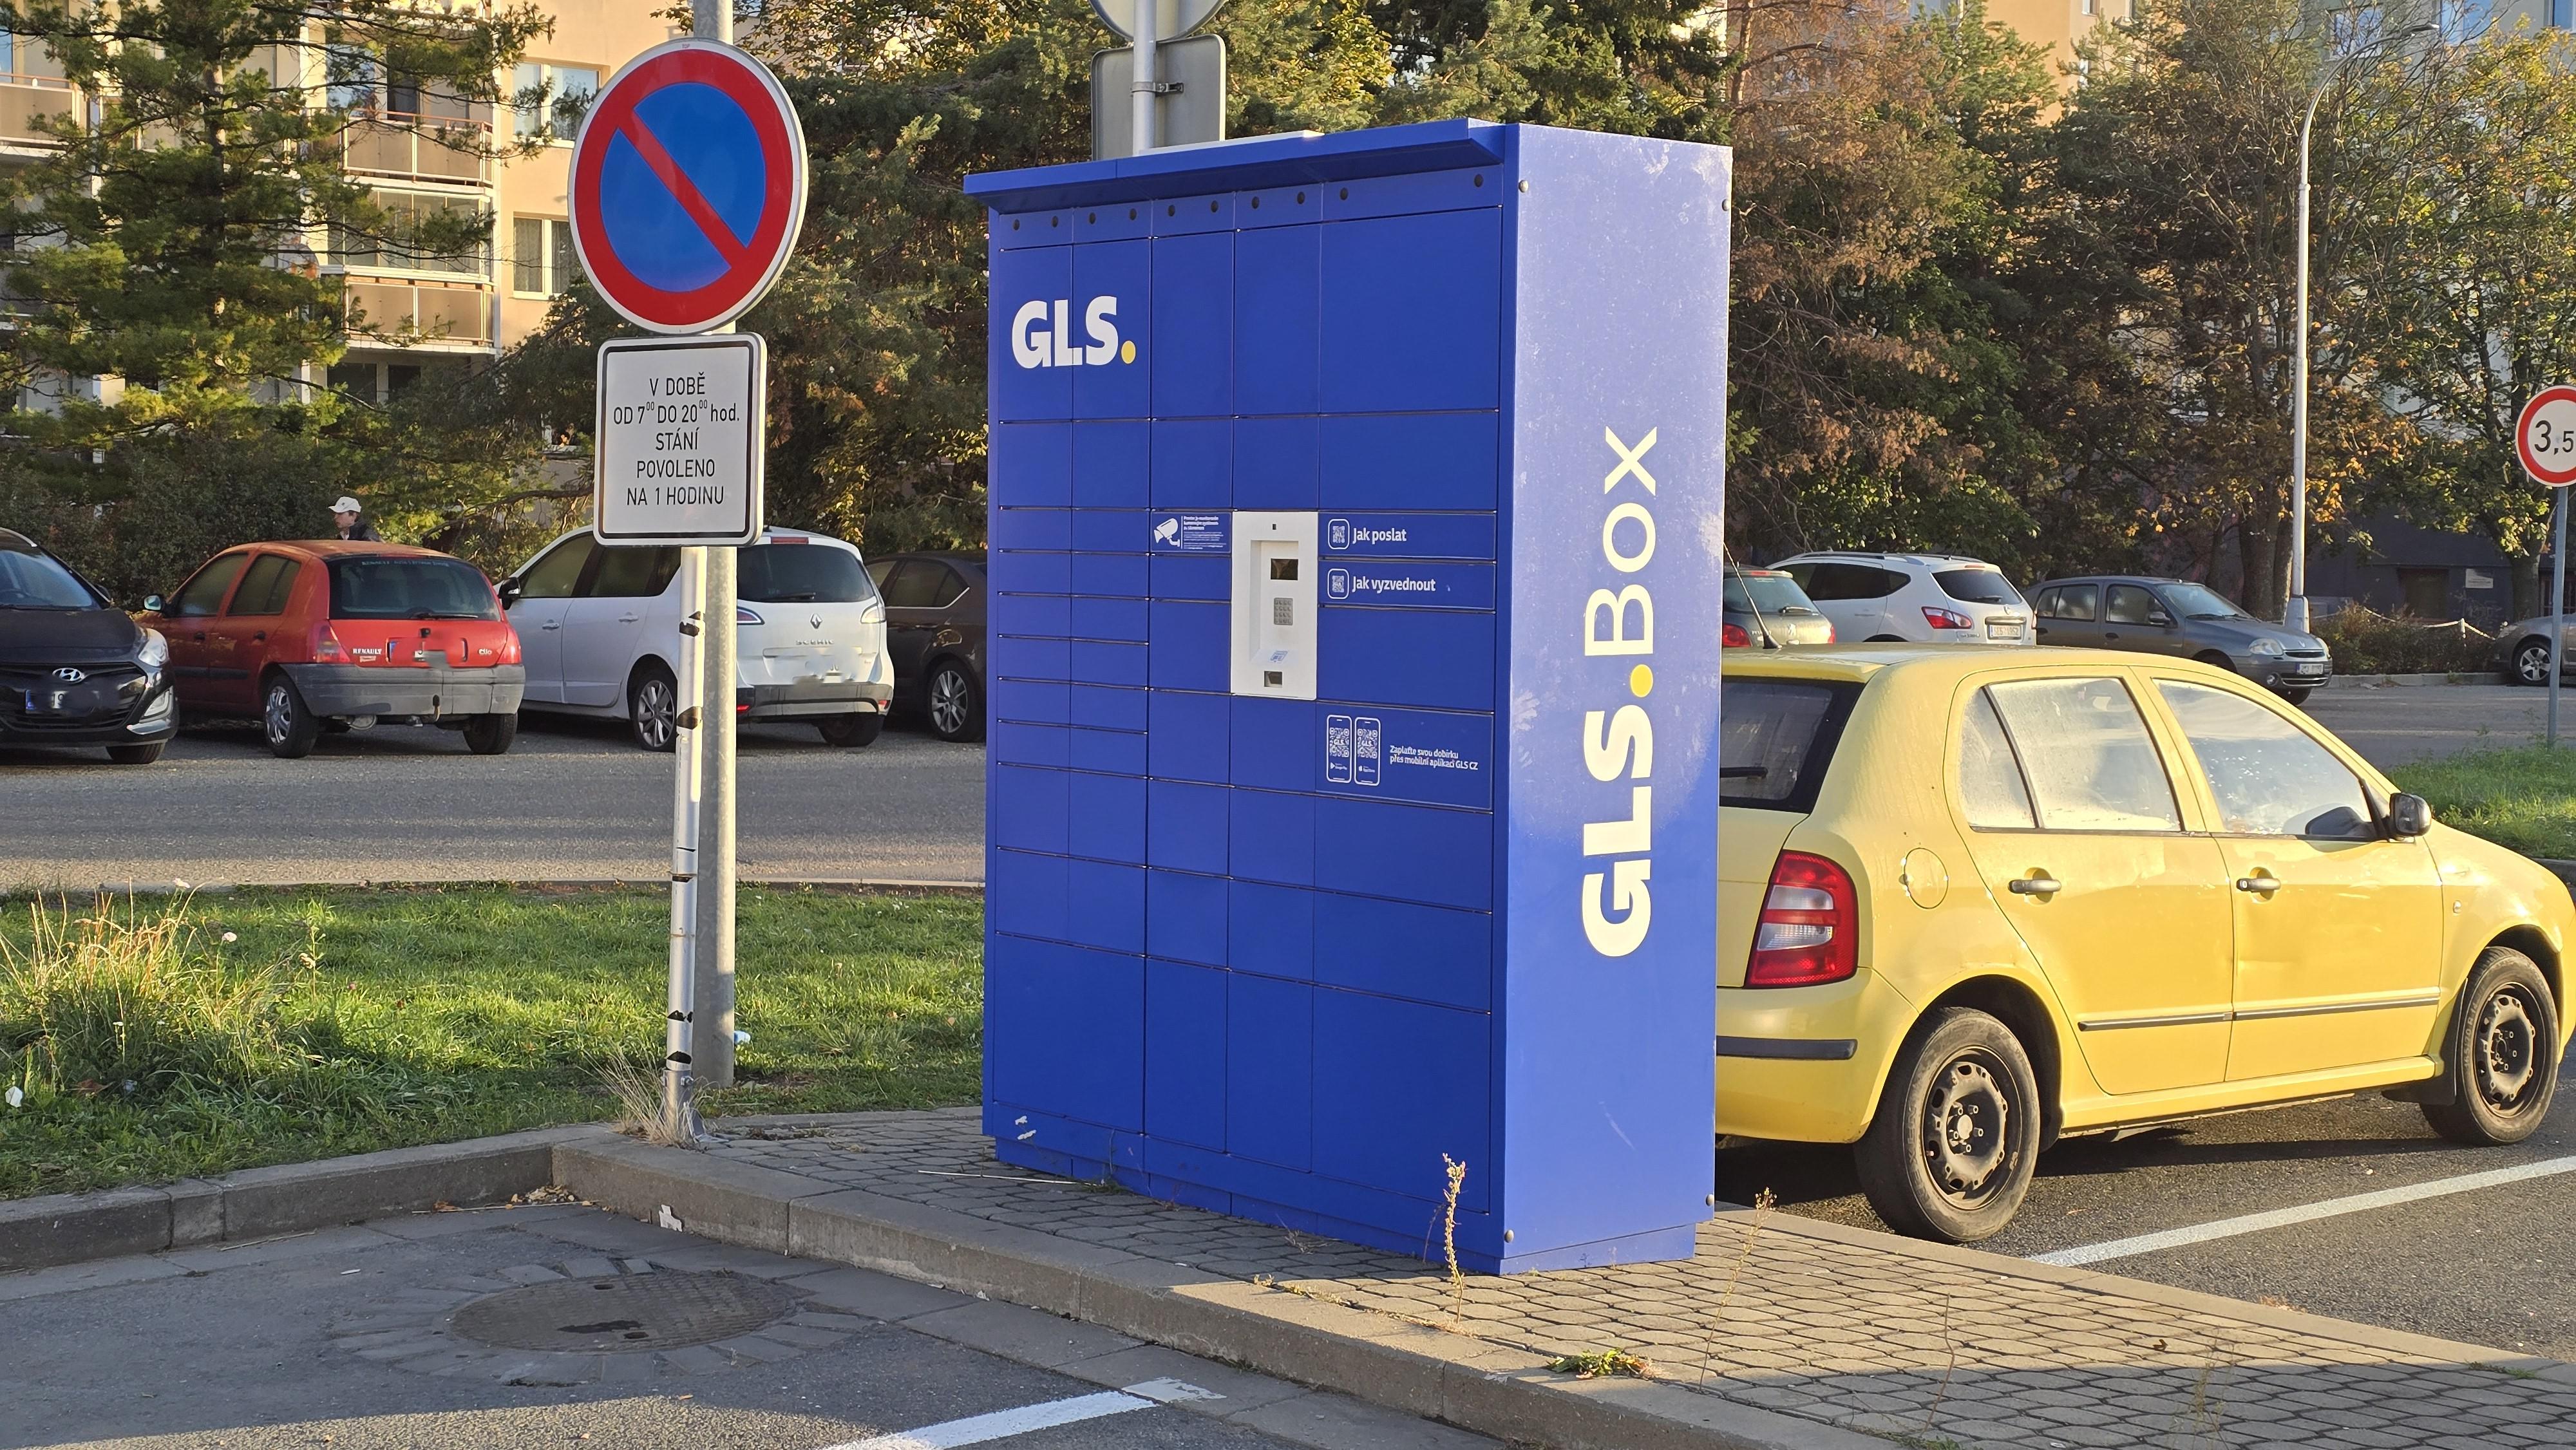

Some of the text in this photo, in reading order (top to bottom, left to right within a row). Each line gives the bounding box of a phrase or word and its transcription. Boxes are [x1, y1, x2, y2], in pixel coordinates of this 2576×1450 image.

[649, 372, 706, 397] V DOBĚ
[614, 406, 633, 425] OD
[658, 404, 677, 424] DO
[710, 403, 740, 422] hod.
[656, 427, 700, 451] STÁNÍ
[2534, 420, 2575, 456] 3,5
[637, 458, 715, 478] POVOLENO
[627, 485, 724, 505] NA 1 HODINU
[1352, 527, 1407, 545] Jak poslat
[1352, 576, 1436, 594] Jak vyzvednout
[1390, 753, 1404, 764] přes
[1404, 756, 1429, 765] mobilní
[1455, 760, 1468, 769] GLS
[1469, 762, 1479, 770] CZ
[1434, 748, 1459, 758] dobírku
